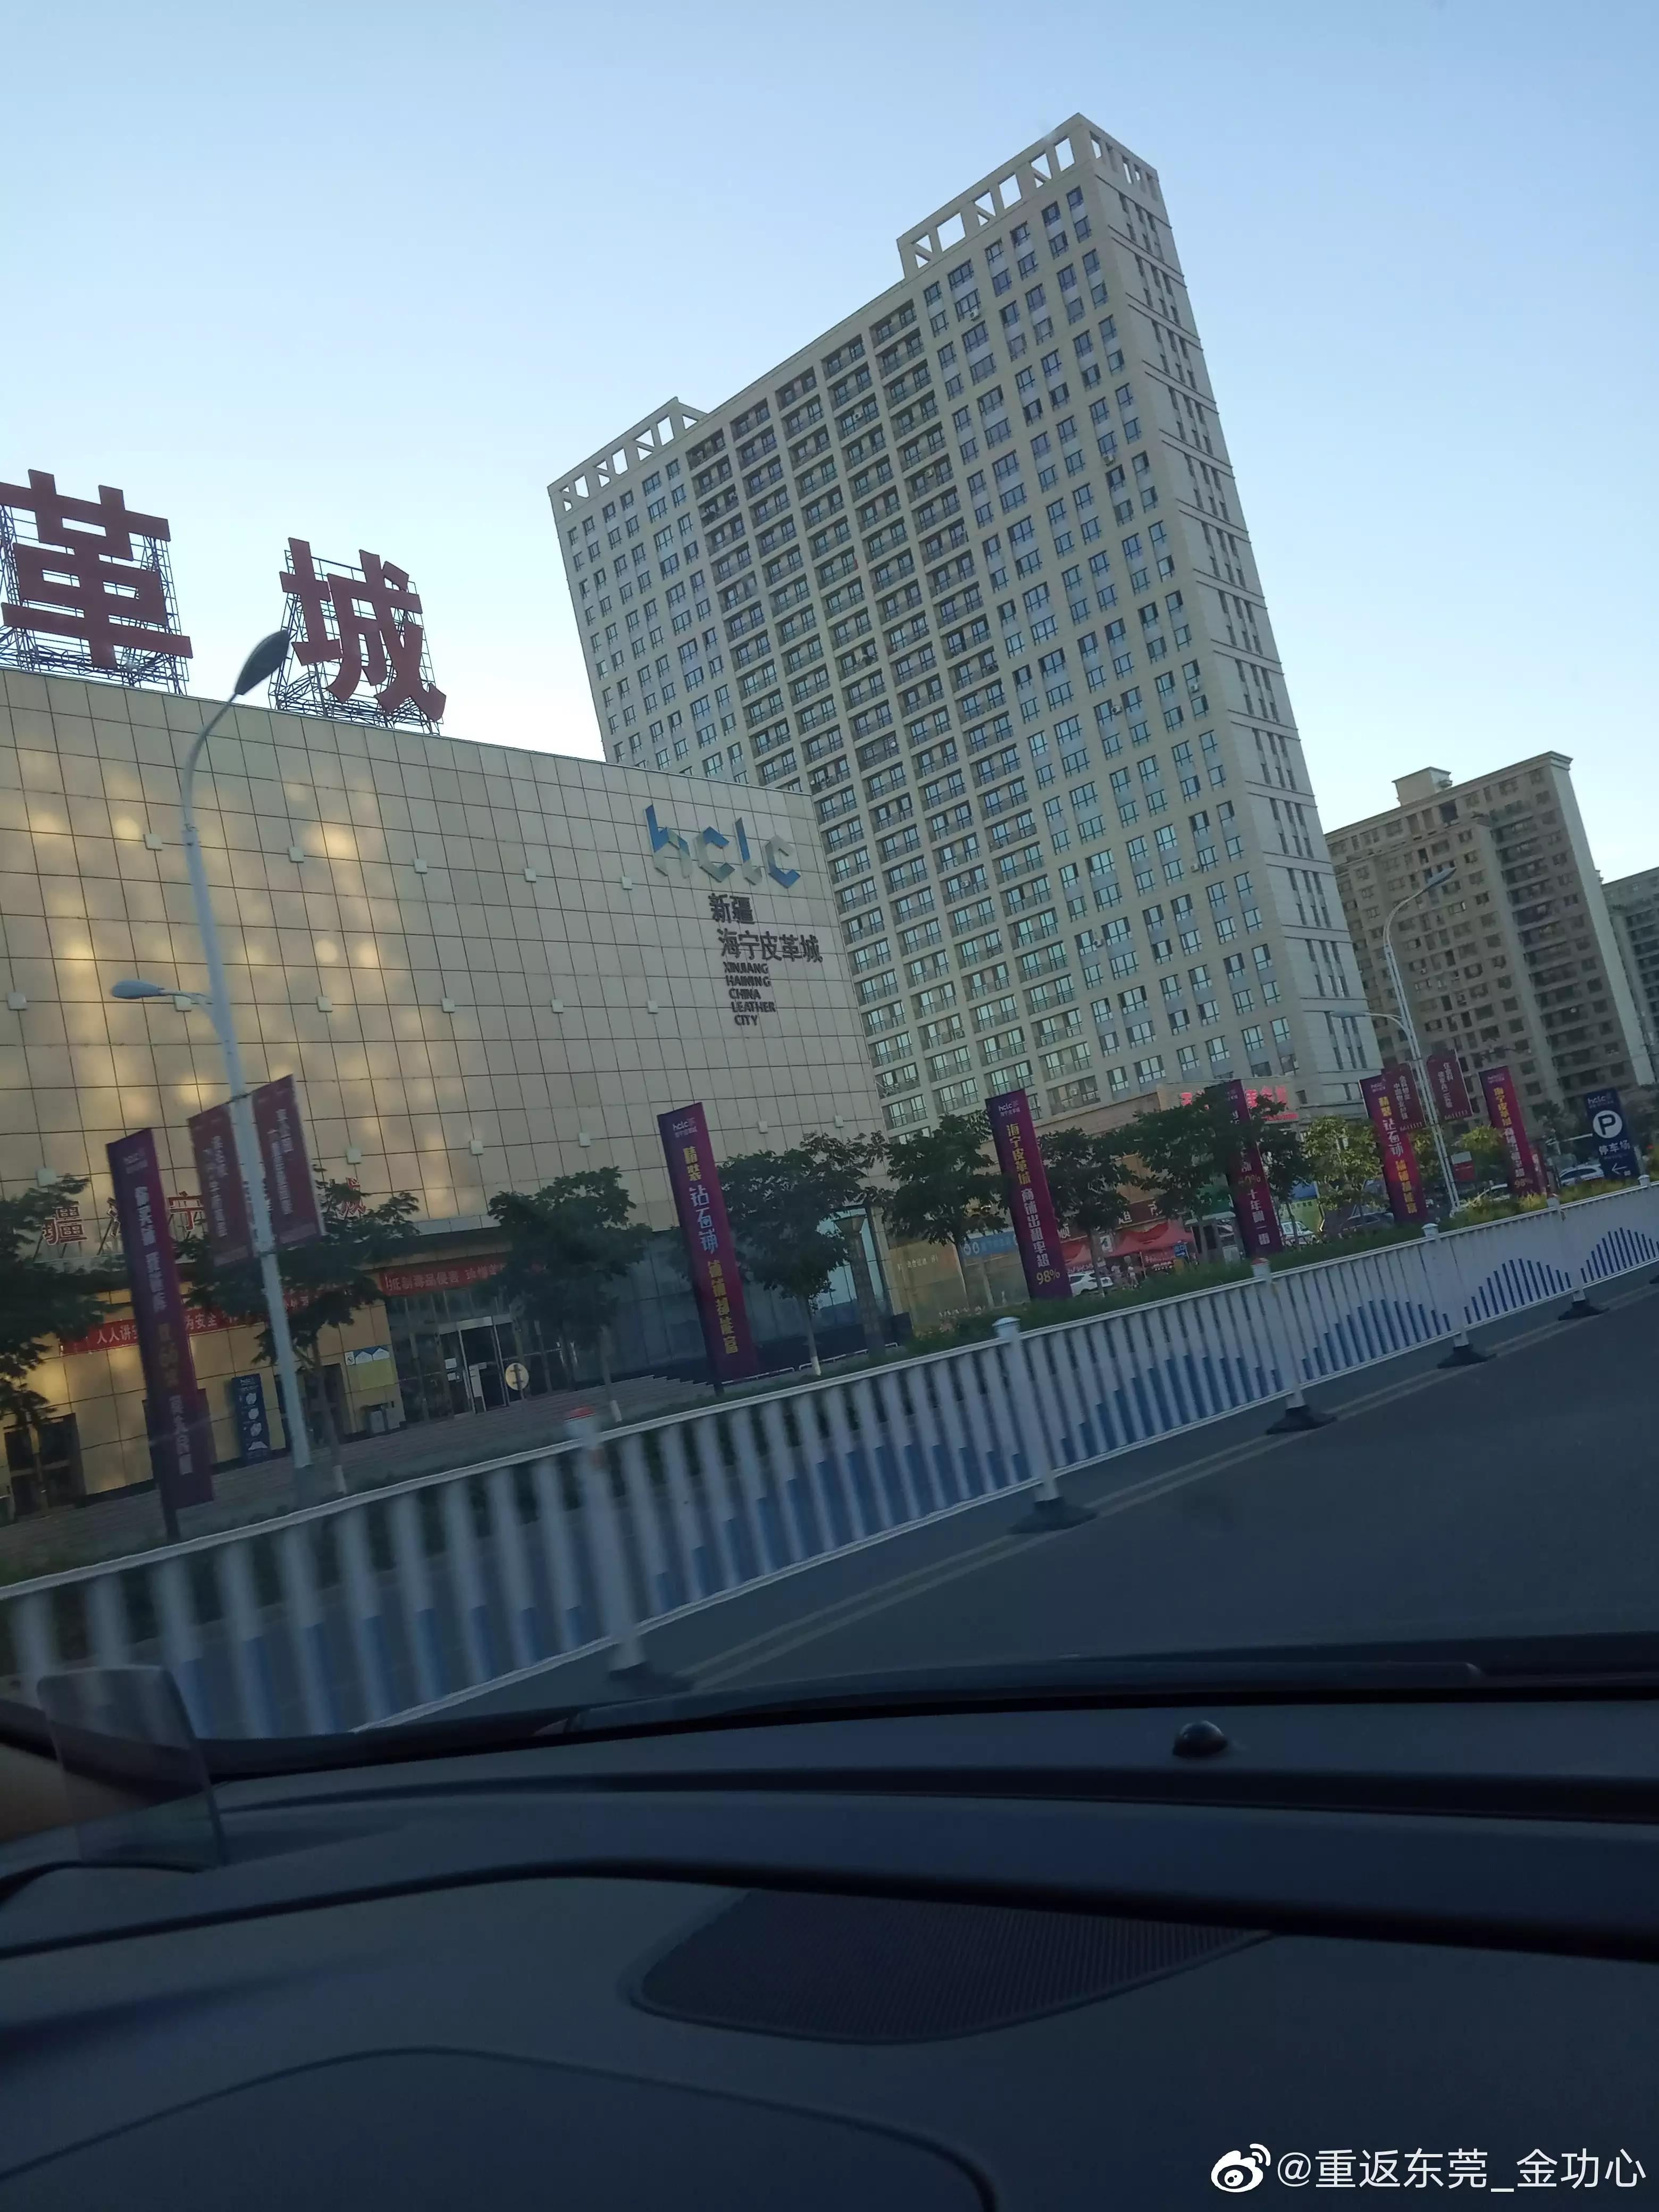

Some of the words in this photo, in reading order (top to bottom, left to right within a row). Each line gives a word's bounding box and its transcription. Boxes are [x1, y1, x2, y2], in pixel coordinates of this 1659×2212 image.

[708, 893, 755, 924] 新疆
[717, 928, 823, 963] 海宁皮革城
[723, 961, 769, 974] XINJIANG
[725, 975, 771, 987] HAINING
[729, 988, 761, 999] CHINA
[731, 1001, 776, 1012] LEATHER
[734, 1015, 758, 1026] CITY
[1598, 1114, 1616, 1135] P
[1006, 1123, 1032, 1185] 海宁皮革城
[1598, 1139, 1631, 1155] 停车场
[1036, 1269, 1061, 1285] 98%
